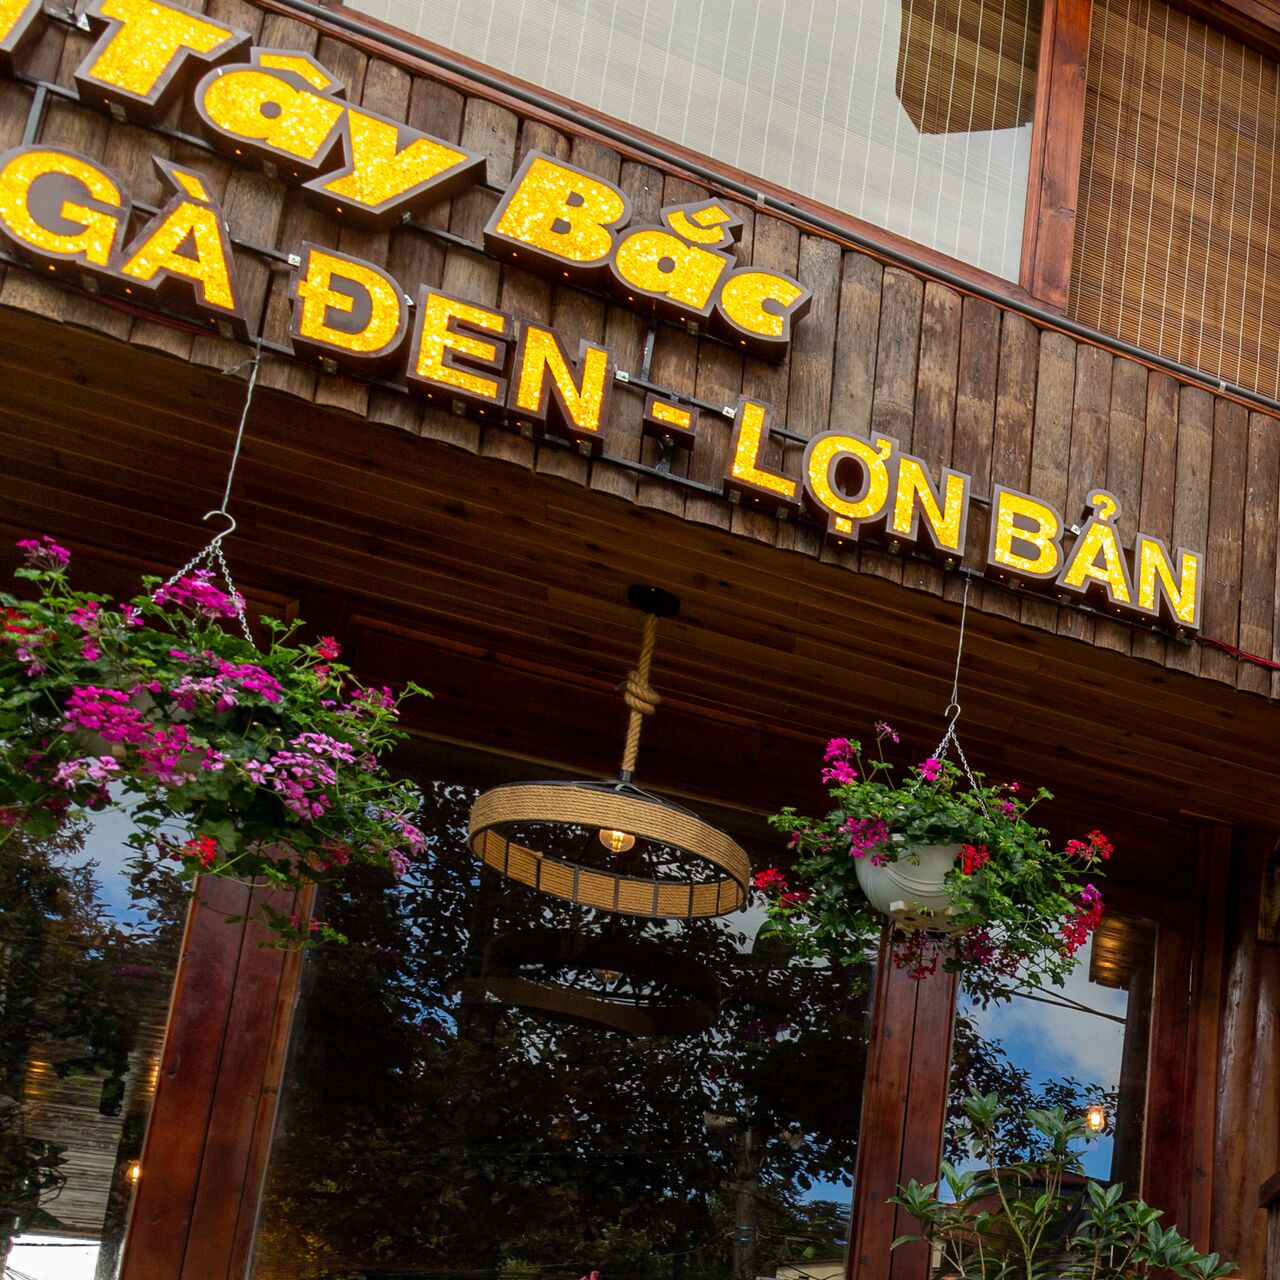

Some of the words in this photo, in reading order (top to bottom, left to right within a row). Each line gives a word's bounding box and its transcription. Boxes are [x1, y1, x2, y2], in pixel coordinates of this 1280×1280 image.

[86, 0, 472, 209] Tây
[494, 154, 806, 340] Bắc
[0, 149, 237, 312] GÀ
[295, 249, 611, 434] ĐEN
[729, 400, 967, 552] LỢN
[992, 488, 1202, 626] BẢN
